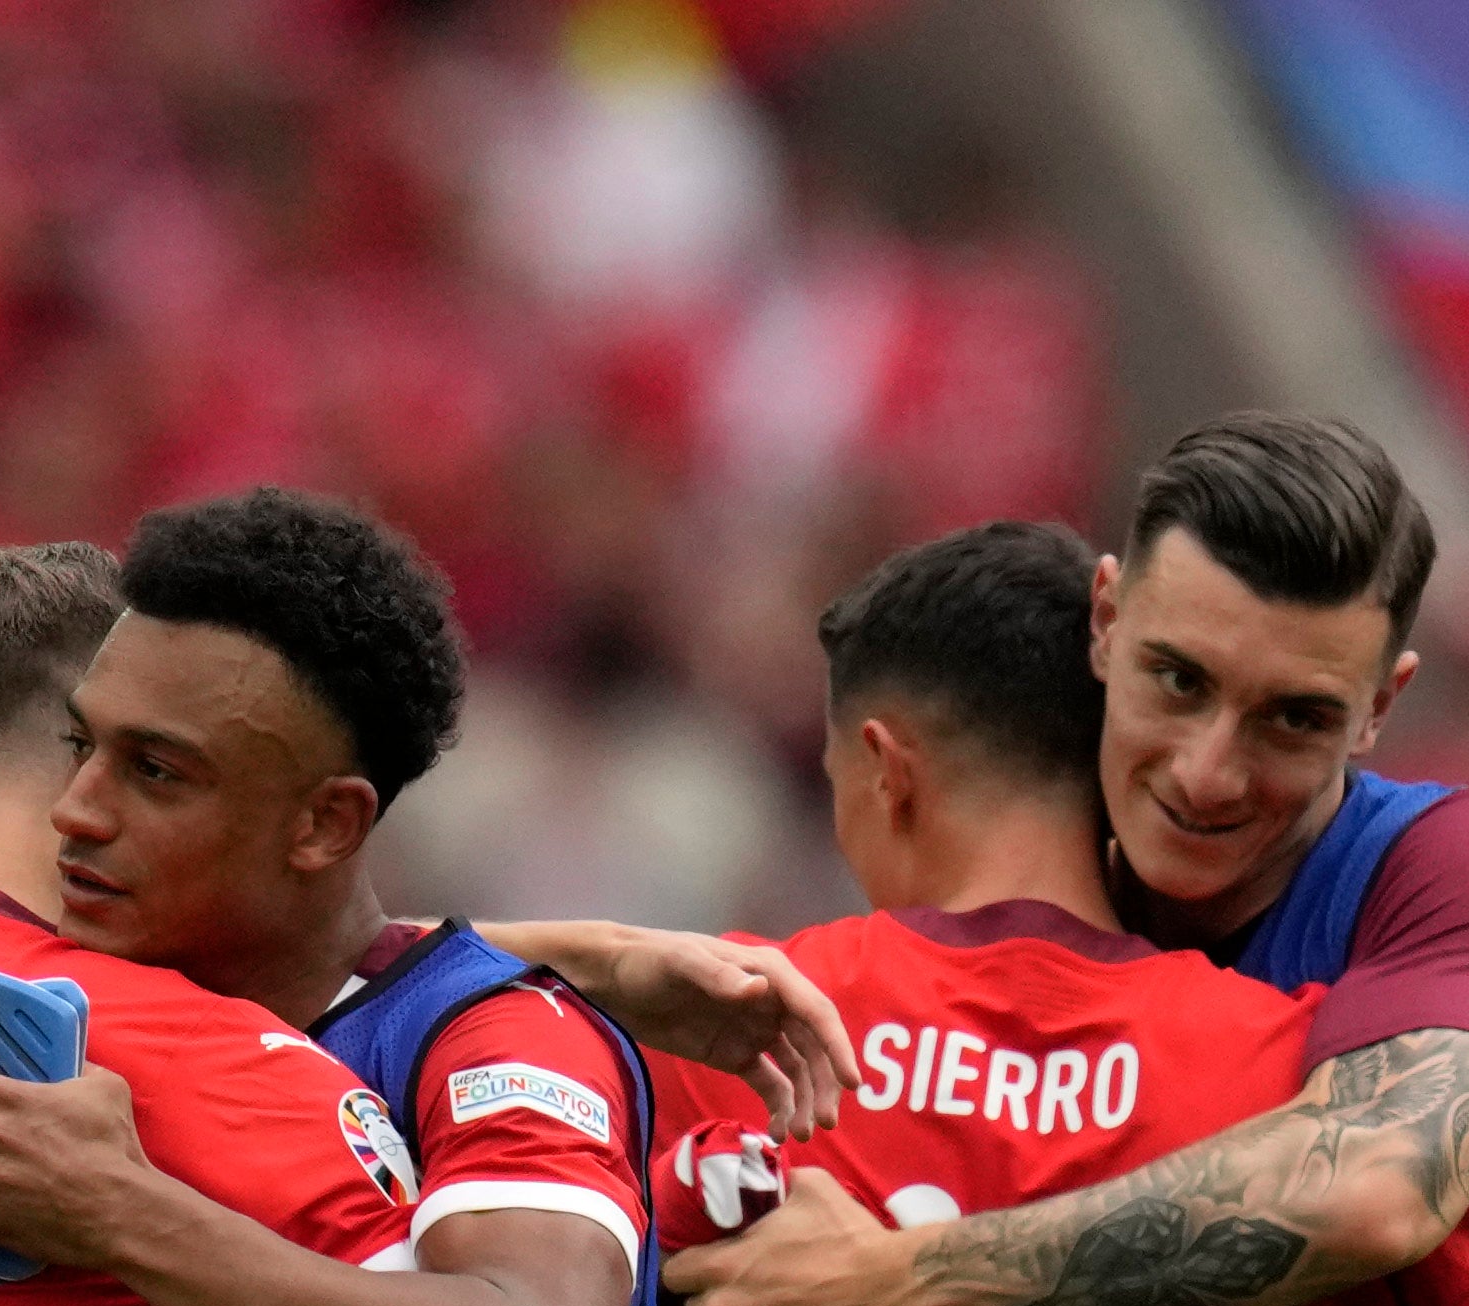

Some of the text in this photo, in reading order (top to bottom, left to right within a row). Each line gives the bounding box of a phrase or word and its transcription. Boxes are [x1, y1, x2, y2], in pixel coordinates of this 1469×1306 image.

[454, 1070, 491, 1087] UEFA
[455, 1076, 606, 1128] FOUNDATION
[856, 1022, 1140, 1135] SIERRO
